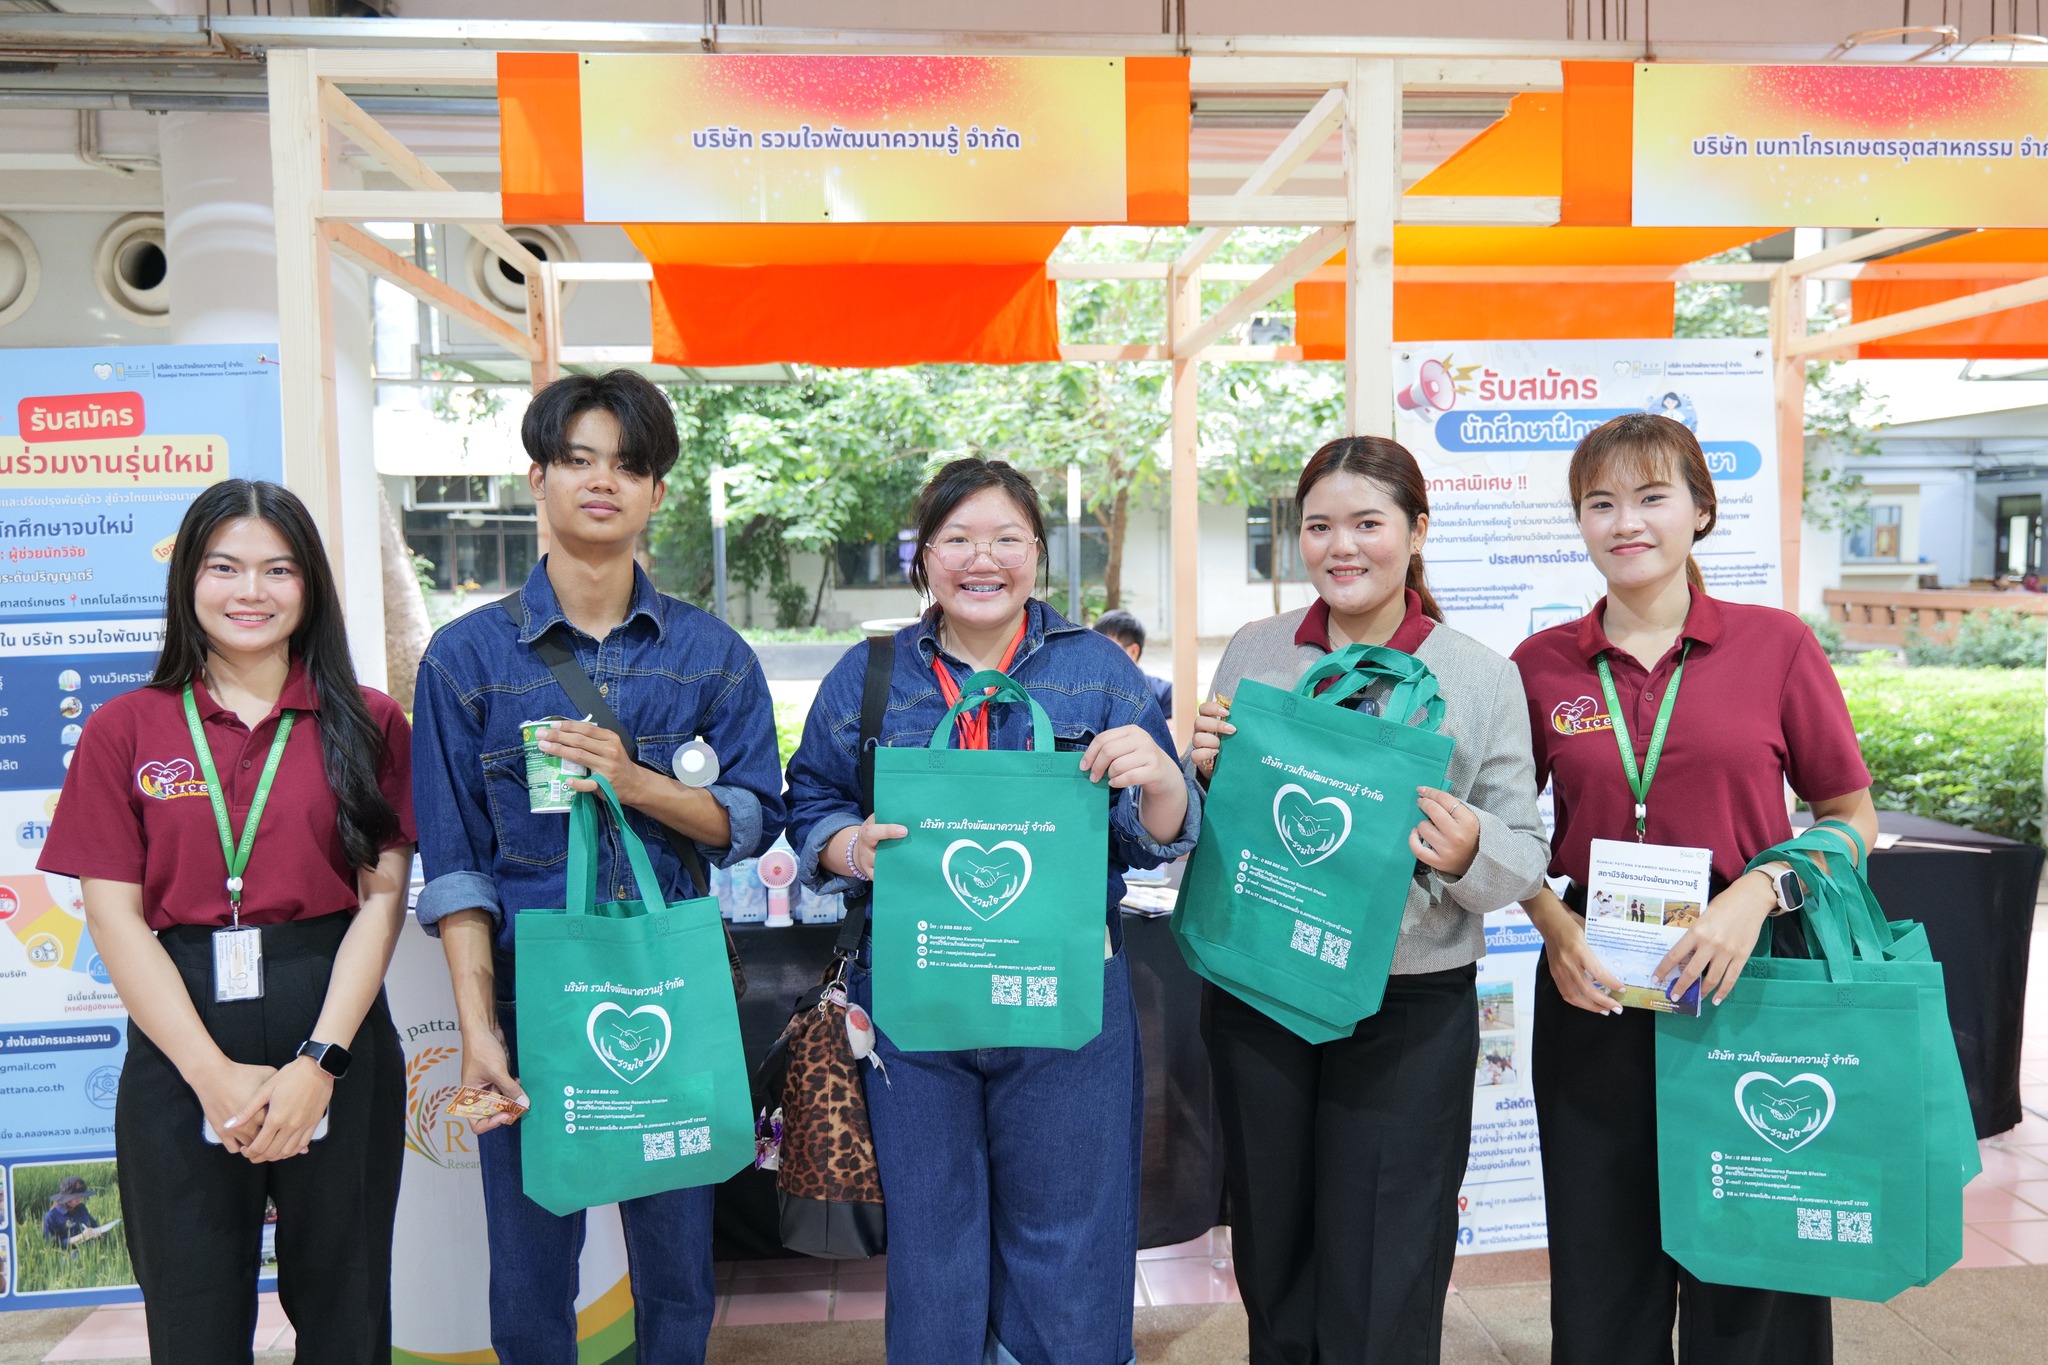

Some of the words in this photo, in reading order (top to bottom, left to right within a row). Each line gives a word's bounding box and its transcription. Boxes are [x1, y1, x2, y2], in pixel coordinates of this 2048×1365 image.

[693, 127, 753, 148] บริษัท
[761, 125, 958, 155] รวมใจพัฒนาความรู้
[966, 127, 1020, 148] จำกัด
[1693, 136, 1747, 155] บริษัท
[1756, 134, 2013, 163] เบทาโกรเกษตรอุตสาหกรรม
[1479, 368, 1598, 401] รับสมัคร
[30, 403, 135, 432] รับสมัคร
[1460, 412, 1603, 443] นักศึกษาฝึก
[0, 495, 101, 508] และปรับปรุงพันธุ์ข้าว
[105, 491, 200, 507] สู่ข้าวไทยแห่งอนาค
[9, 546, 86, 563] ผู้ช่วยนักวิจัย
[80, 593, 167, 606] เทคโนโลยีการเกษ
[22, 632, 63, 646] บริษัท
[1261, 755, 1283, 769] บริษัท
[1284, 762, 1362, 797] รวมใจพัฒนาความรู้
[1360, 785, 1384, 802] จำกัด
[920, 818, 945, 830] บริษัท
[947, 818, 1029, 835] รวมใจพัฒนาความรู้
[1031, 821, 1056, 833] จำกัด
[1597, 870, 1699, 890] สถานีวิจัยรวมใจพัฒนาความรู้
[564, 981, 588, 992] บริษัท
[590, 981, 664, 997] รวมใจพัฒนาความรู้
[665, 977, 684, 990] จำกัด
[6, 1033, 111, 1047] ส่งใบสมัครและผลงาน
[407, 1019, 460, 1042] patta
[1708, 1050, 1735, 1061] บริษัท
[1737, 1051, 1829, 1067] รวมใจพัฒนาความรู้
[1832, 1053, 1860, 1066] จำกัด
